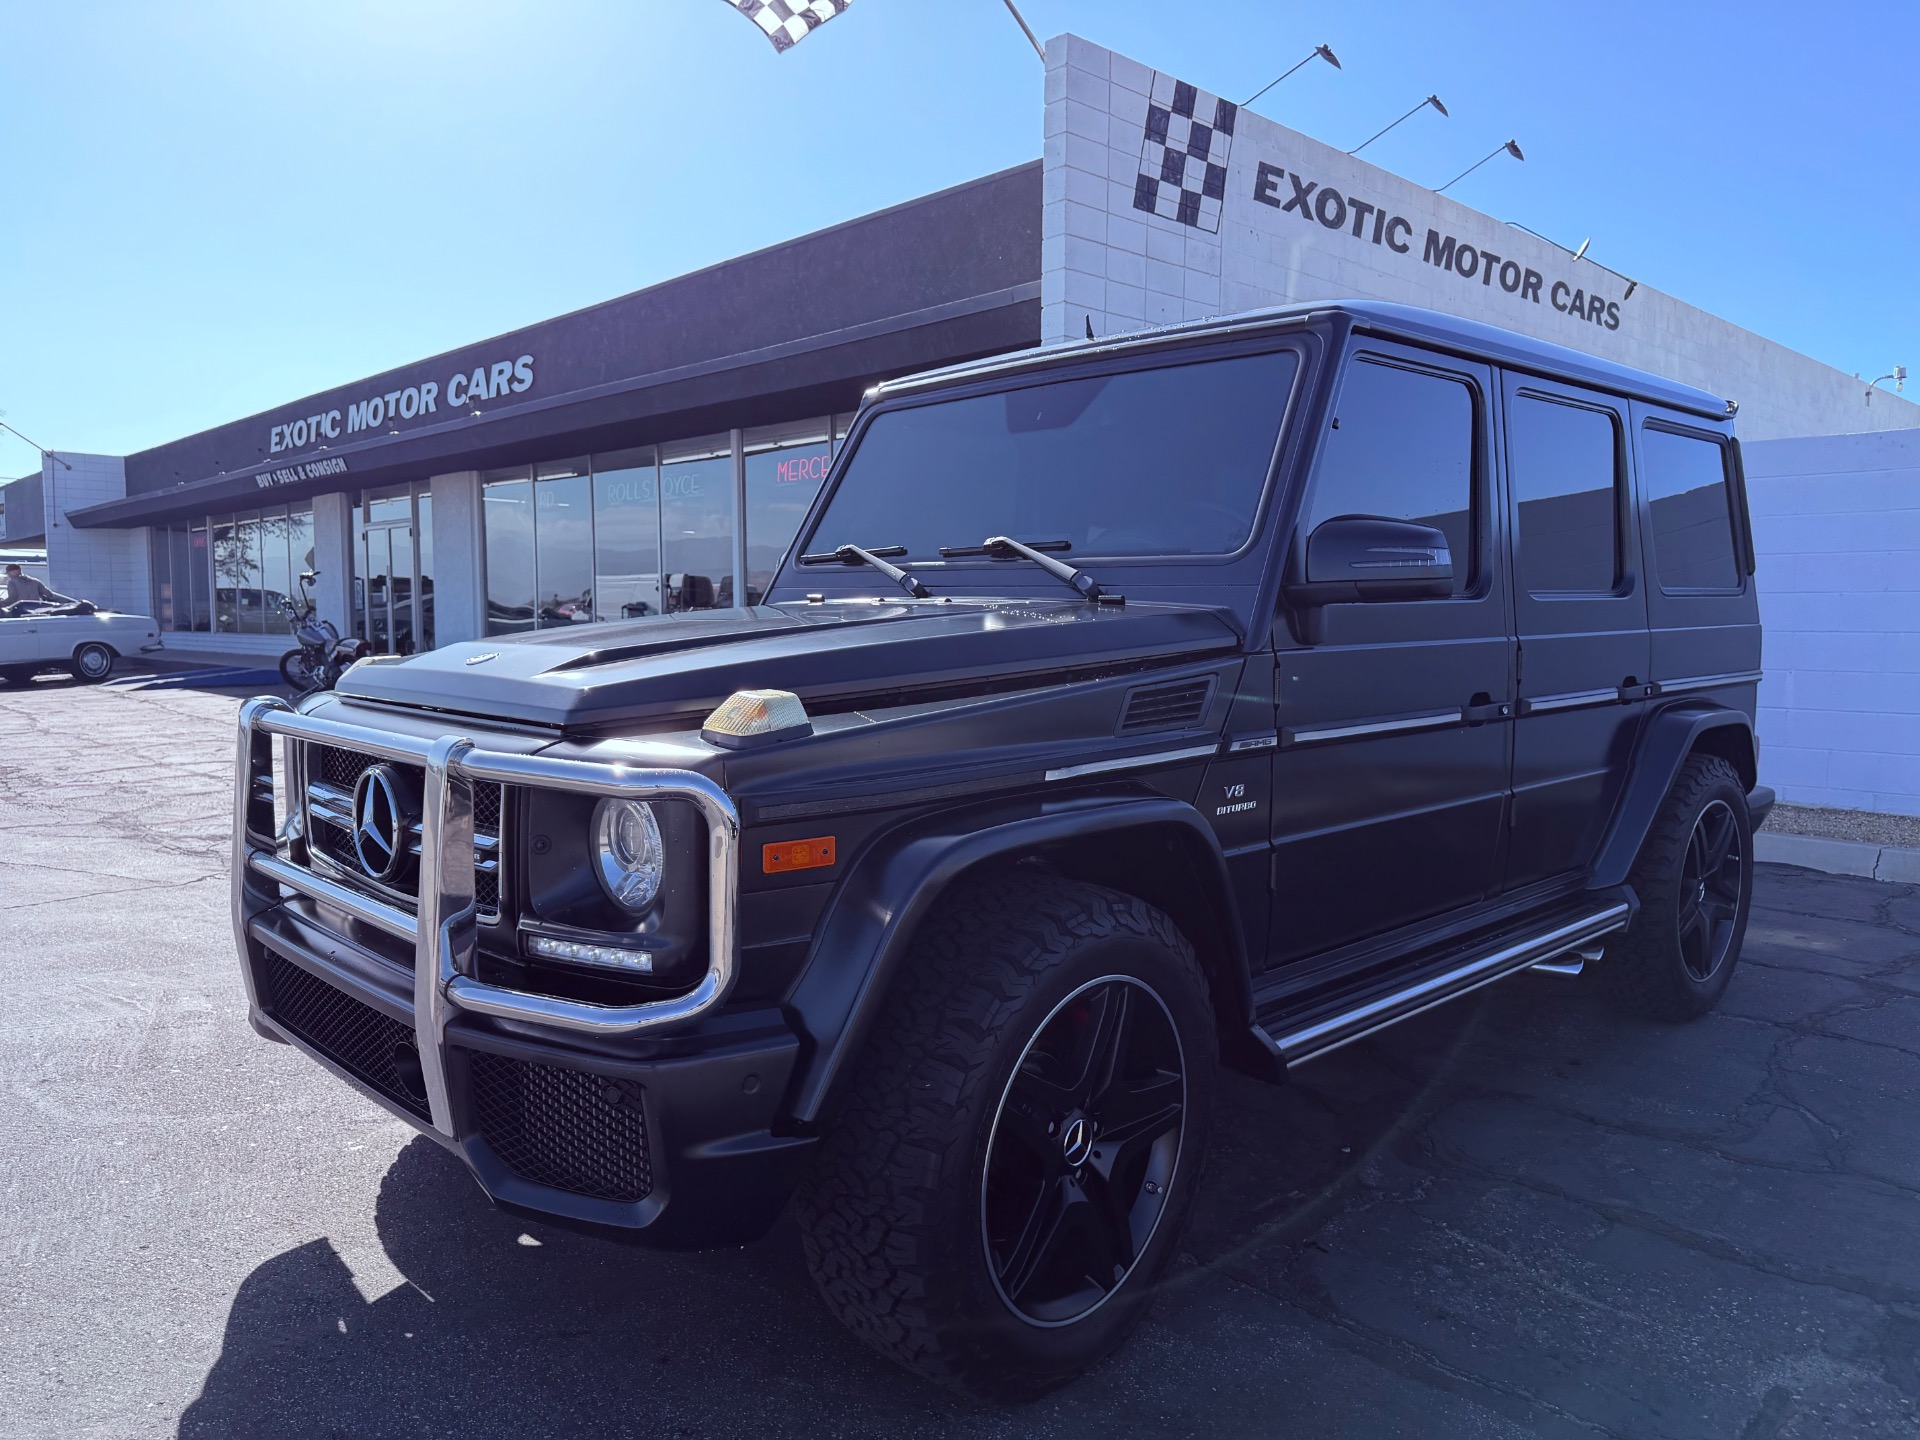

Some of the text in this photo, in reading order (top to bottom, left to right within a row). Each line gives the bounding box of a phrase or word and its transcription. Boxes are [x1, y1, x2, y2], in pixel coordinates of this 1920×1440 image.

[1253, 161, 1620, 331] EXOTIC MOTOR CARS
[270, 355, 534, 453] EXOTIC MOTOR CARS
[255, 457, 348, 489] BUY SELL & CONSIGN
[608, 480, 650, 502] ROLLS
[1249, 738, 1272, 747] AMG
[1224, 784, 1245, 799] V8
[1216, 801, 1257, 815] BITURBO
